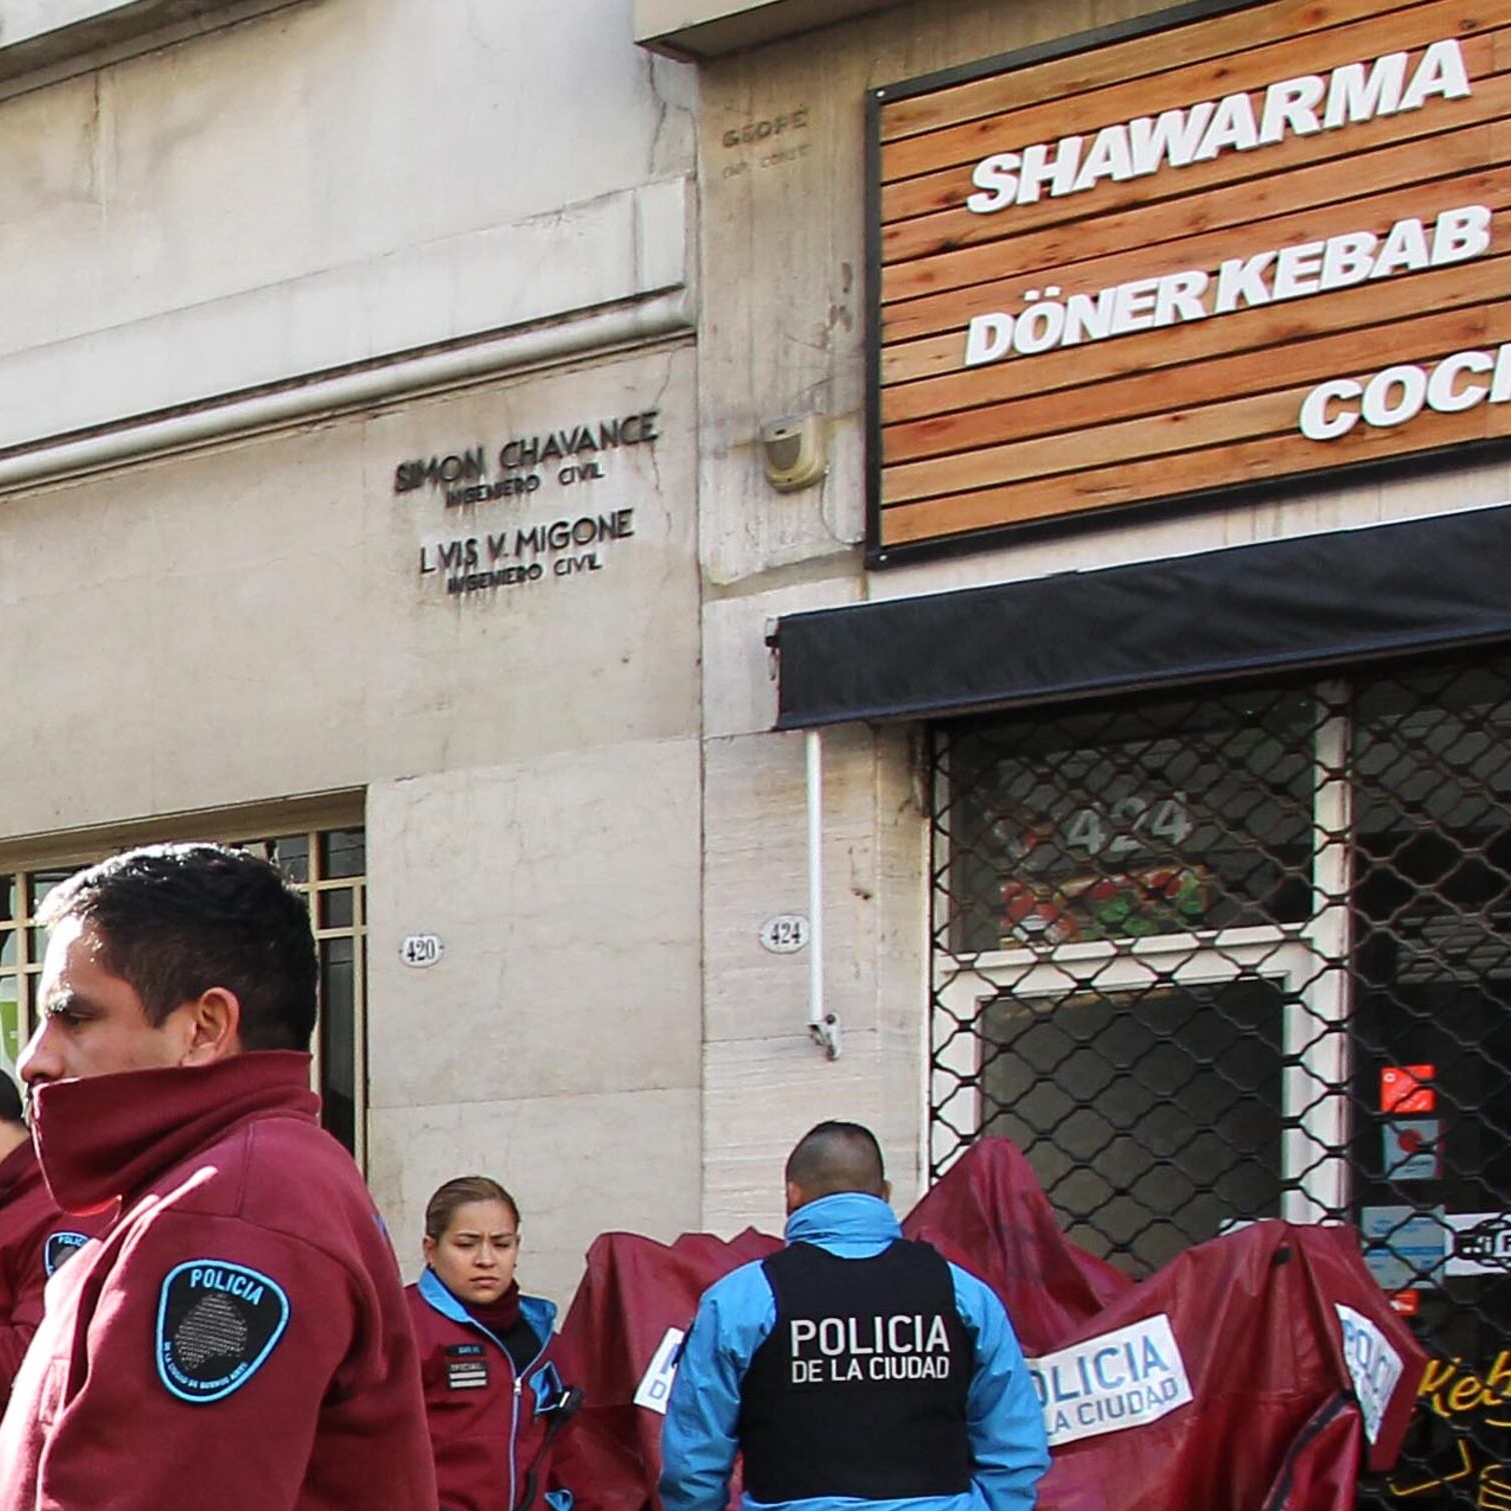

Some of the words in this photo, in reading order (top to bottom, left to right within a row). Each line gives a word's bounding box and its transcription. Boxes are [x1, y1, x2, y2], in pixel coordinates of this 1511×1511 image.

[967, 38, 1472, 214] SHAWARMA
[964, 270, 1209, 368] DÖNER
[1213, 205, 1492, 315] KEBAB
[499, 411, 659, 469] CHAVANCE
[558, 462, 606, 485] CIVIL
[515, 508, 635, 557] MIGONE
[554, 554, 603, 577] CIVIL
[407, 940, 436, 962] 420
[770, 922, 801, 945] 424
[190, 1268, 265, 1306] POLICIA
[790, 1314, 951, 1357] POLICIA
[791, 1359, 824, 1384] DE
[831, 1358, 864, 1382] LA
[869, 1356, 950, 1380] CIUDAD
[1029, 1335, 1170, 1408] OLICIA
[1047, 1410, 1072, 1436] A
[1076, 1377, 1178, 1426] CIUDAD
